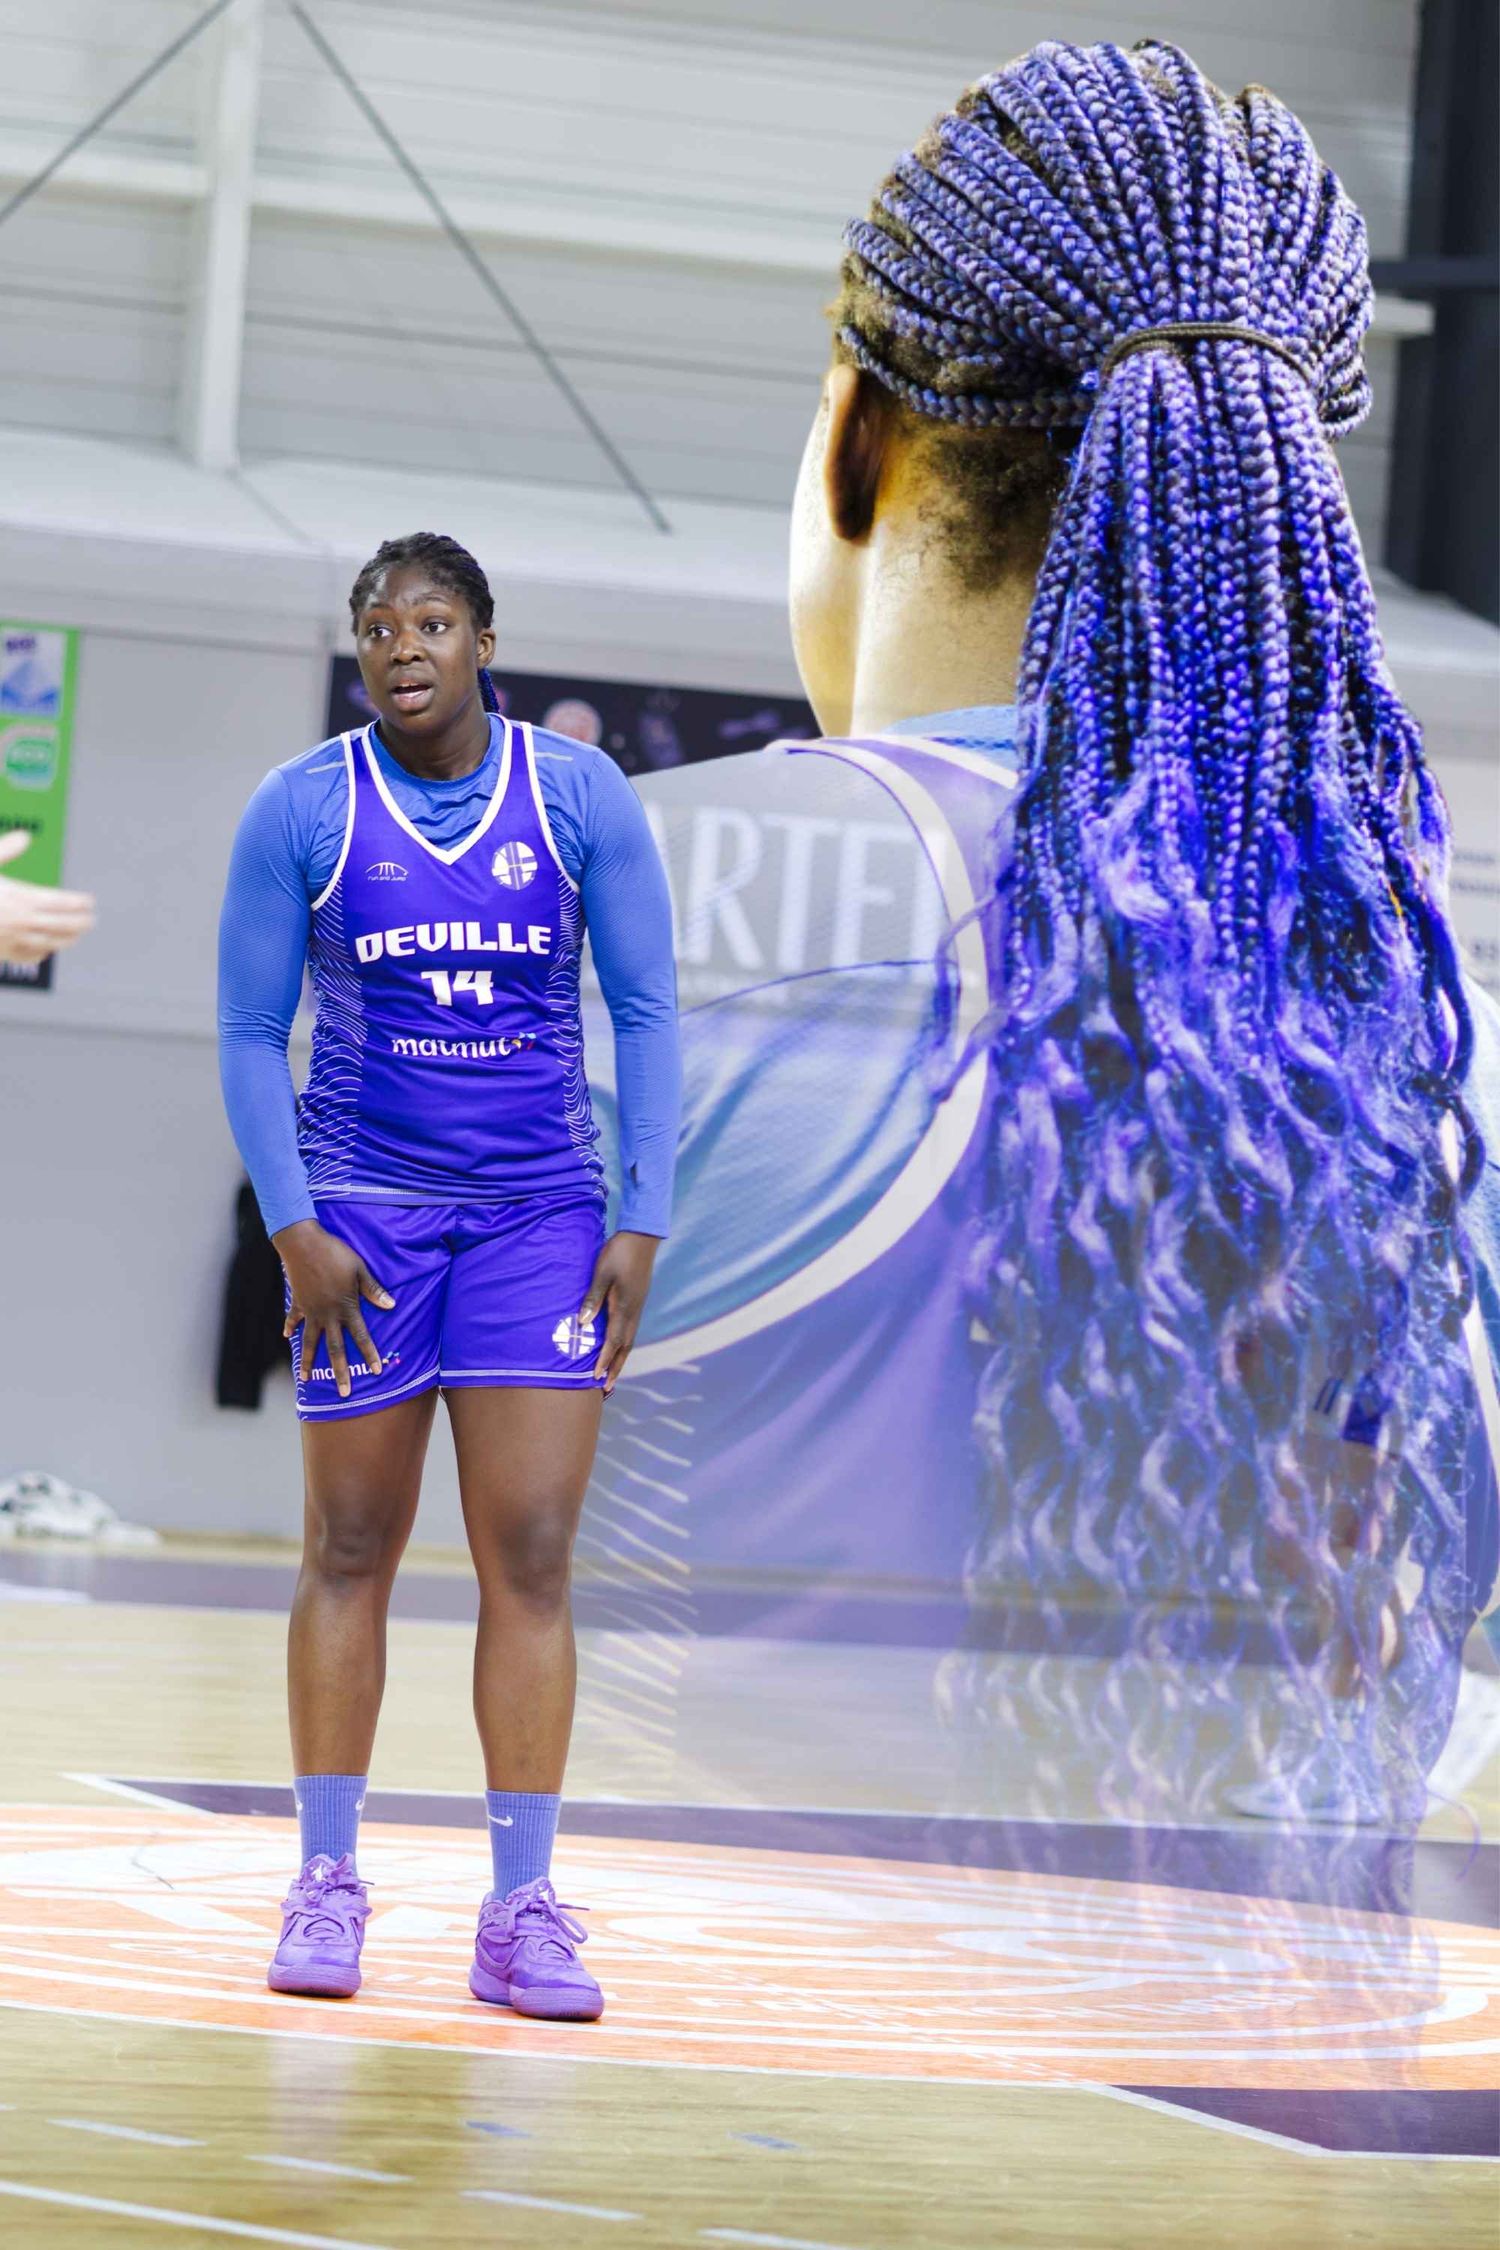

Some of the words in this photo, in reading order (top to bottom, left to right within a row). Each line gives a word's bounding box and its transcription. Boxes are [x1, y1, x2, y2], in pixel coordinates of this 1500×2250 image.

[355, 921, 551, 963] DEVILLE
[420, 970, 494, 1007] 14
[392, 1036, 512, 1059] matmut
[312, 1362, 373, 1381] mamu
